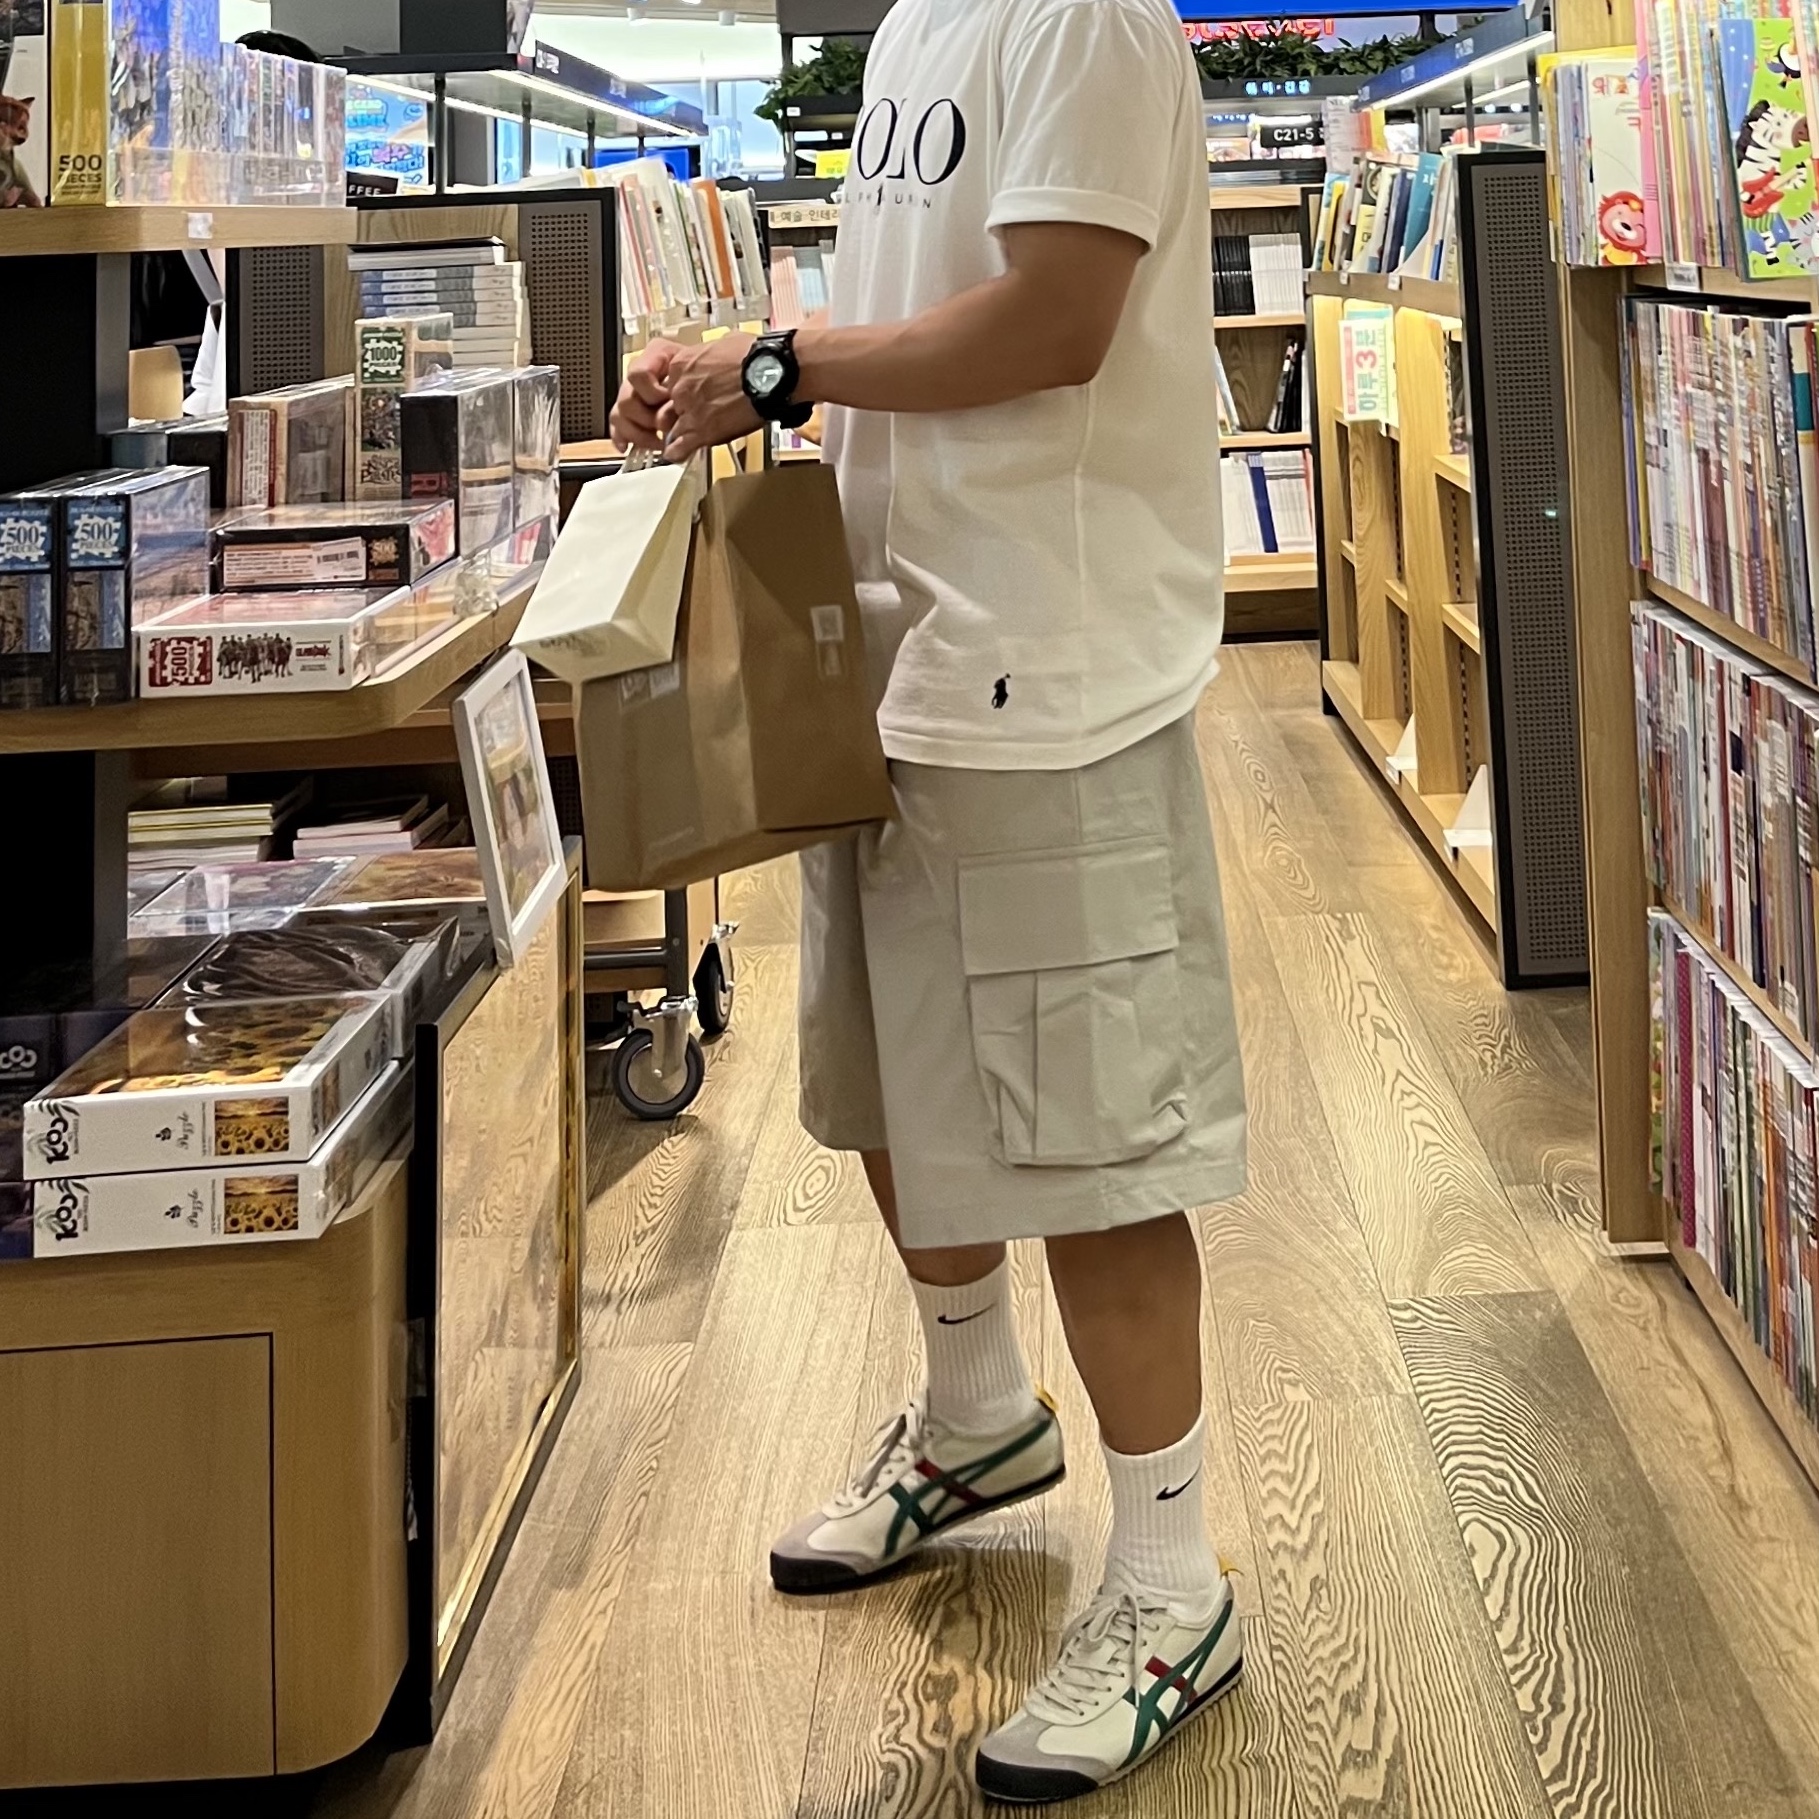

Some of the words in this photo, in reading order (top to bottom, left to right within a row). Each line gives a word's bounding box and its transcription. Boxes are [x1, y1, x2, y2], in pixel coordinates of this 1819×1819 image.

[857, 97, 966, 187] OLO
[1273, 127, 1315, 141] C21-5
[58, 154, 103, 172] 500
[348, 184, 381, 196] FFEE
[808, 208, 838, 222] 인테리
[371, 346, 398, 361] 1000
[6, 526, 40, 545] 500
[80, 522, 113, 541] 500
[171, 646, 187, 677] 500
[175, 1110, 195, 1151] Puzzle
[185, 1188, 205, 1229] Puzzle
